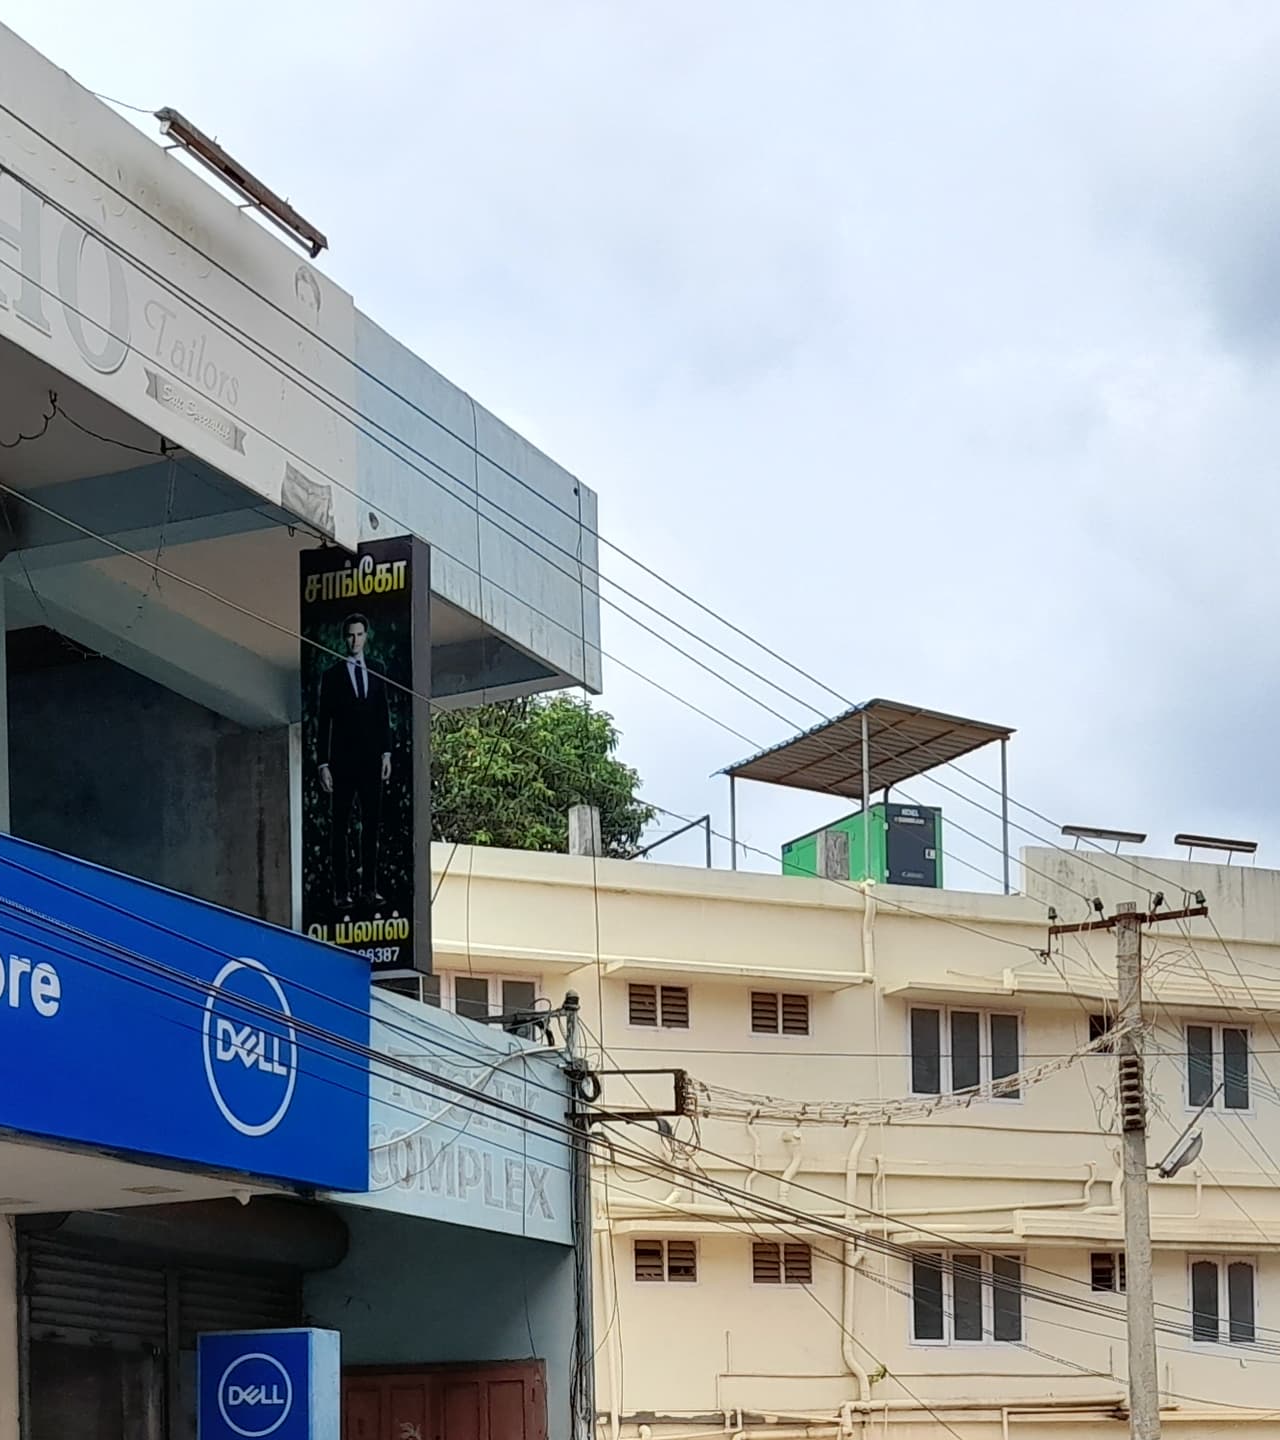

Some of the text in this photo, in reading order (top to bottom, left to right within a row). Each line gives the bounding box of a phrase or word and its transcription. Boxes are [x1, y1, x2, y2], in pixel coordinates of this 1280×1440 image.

[144, 299, 240, 406] Tailors
[304, 554, 408, 603] சாங்கோ
[216, 1018, 288, 1076] DELL
[370, 1121, 556, 1221] COMPLEX
[228, 1384, 285, 1406] DELL
